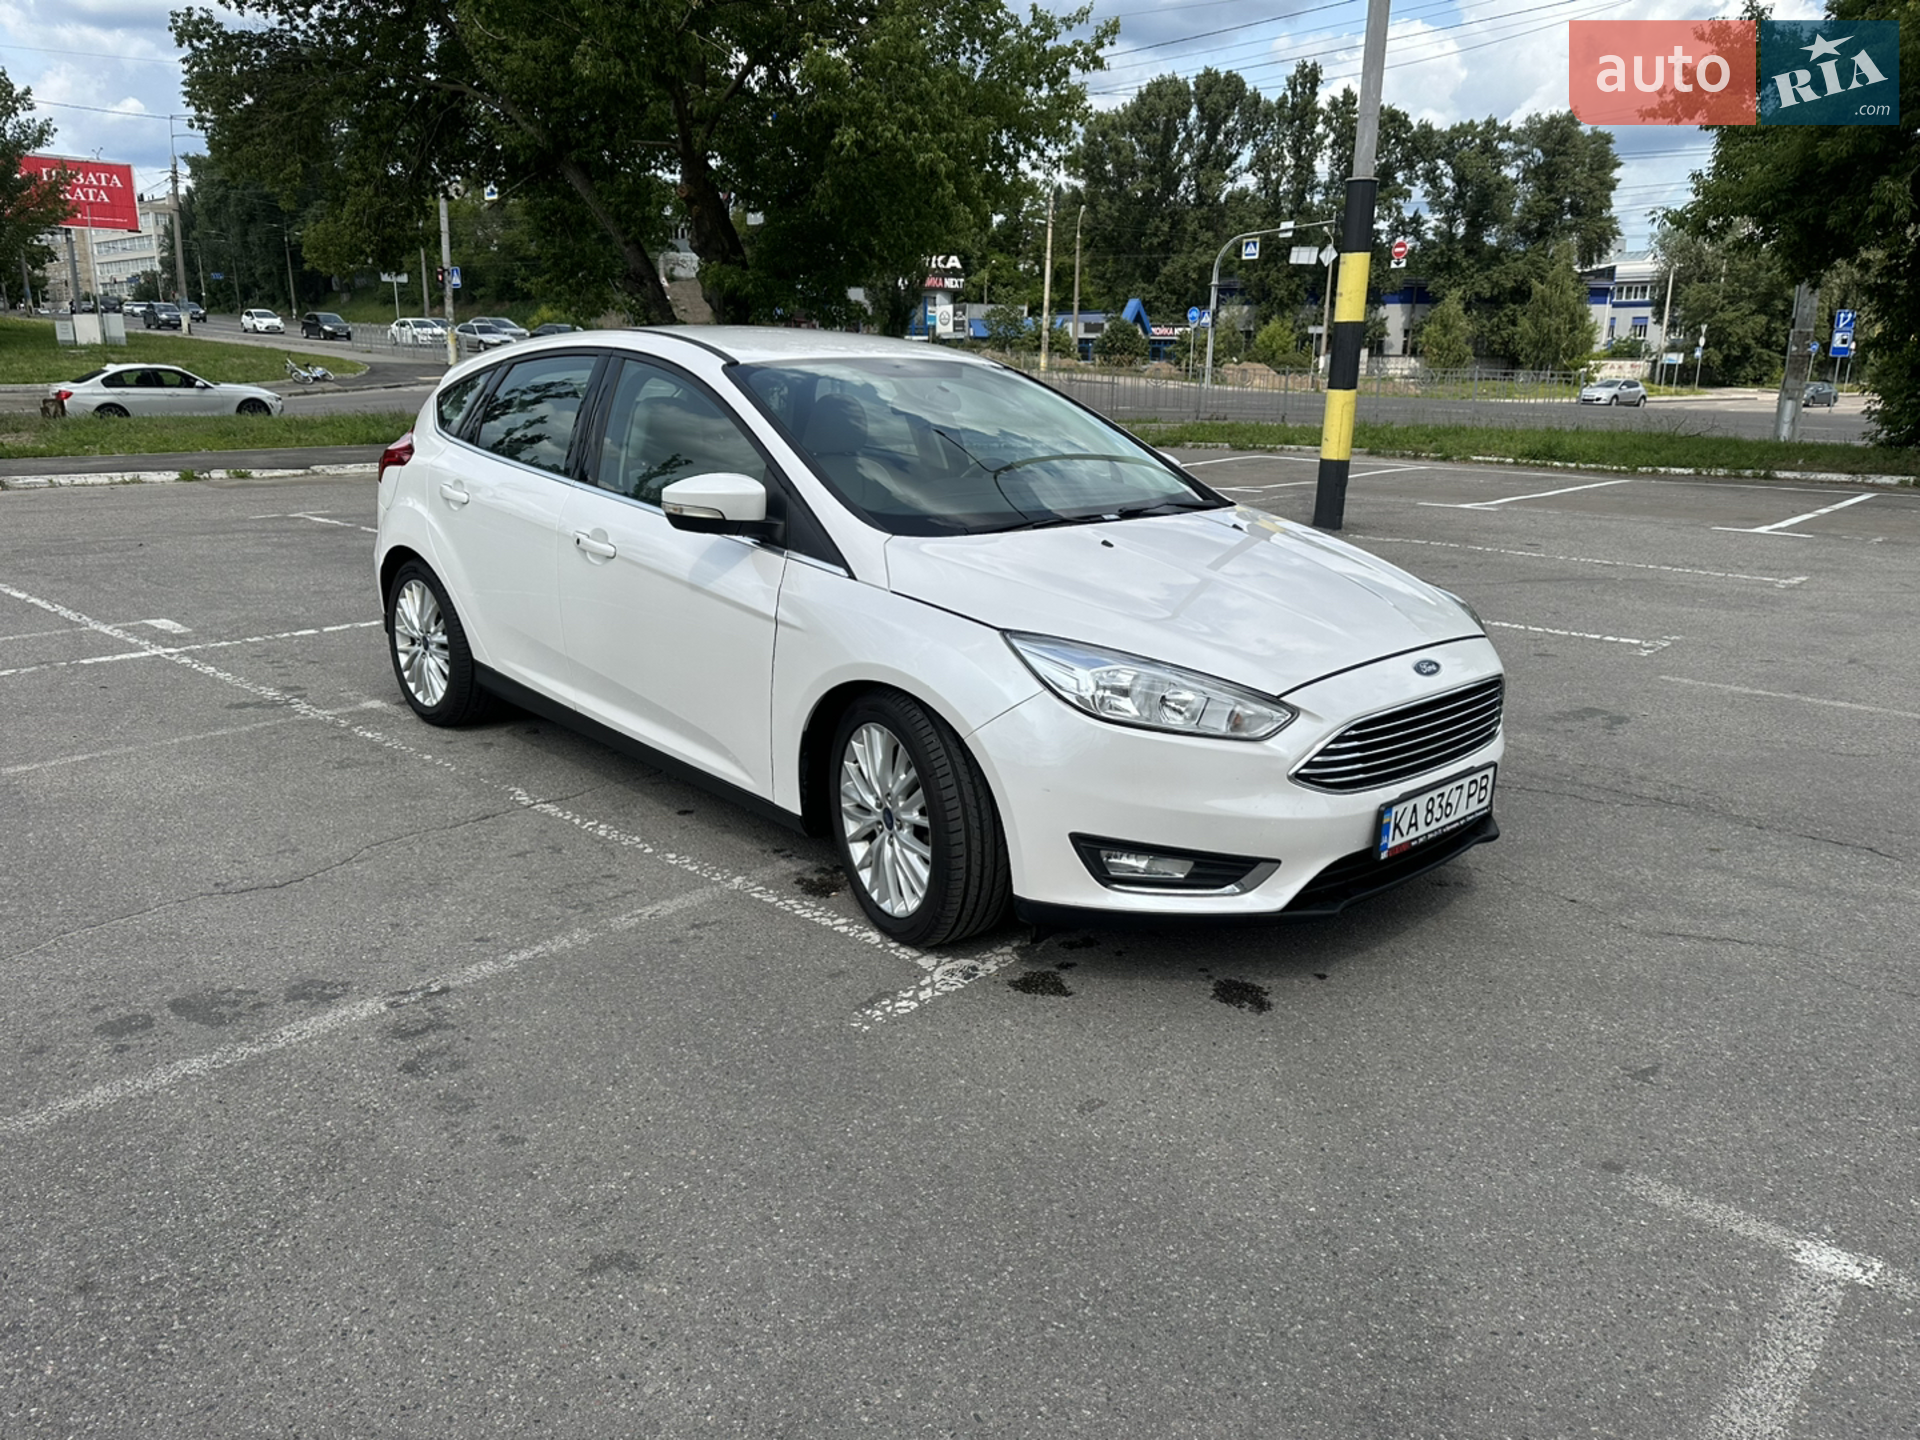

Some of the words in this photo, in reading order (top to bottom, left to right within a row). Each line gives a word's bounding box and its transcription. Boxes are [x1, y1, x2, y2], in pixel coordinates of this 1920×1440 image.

[1392, 803, 1419, 842] KA
[1424, 784, 1464, 827] 8367
[1465, 774, 1490, 810] PB
